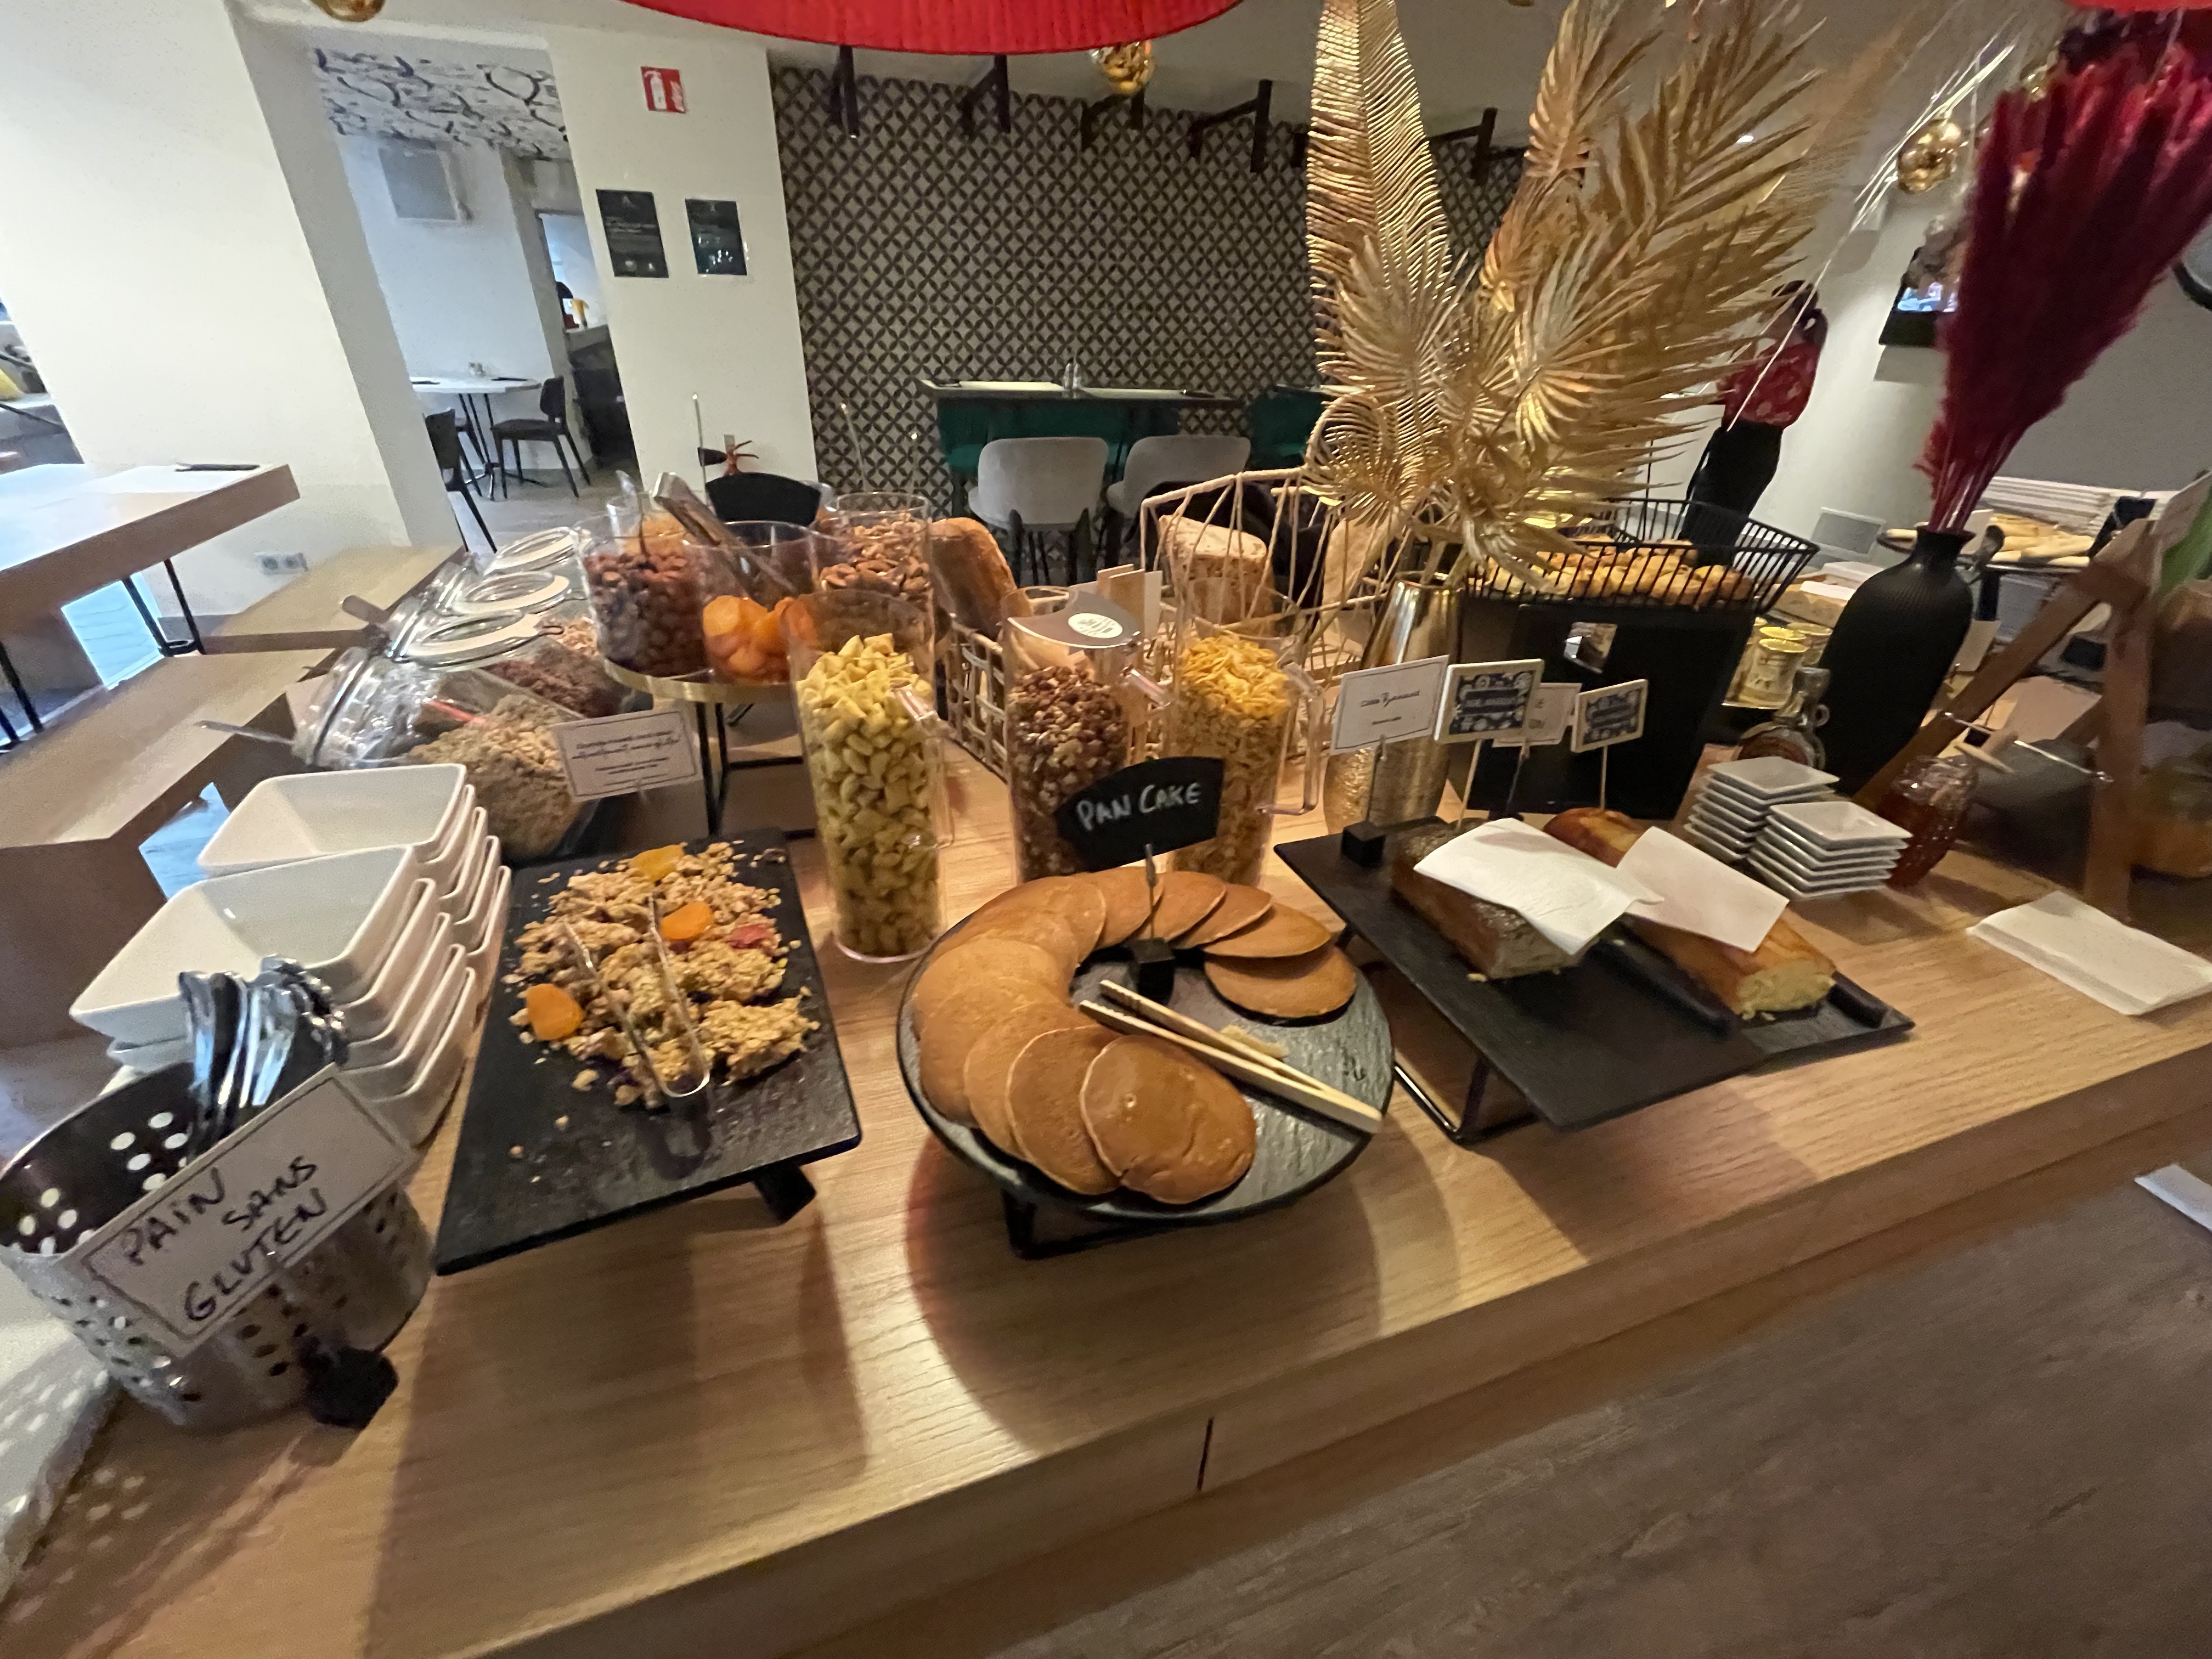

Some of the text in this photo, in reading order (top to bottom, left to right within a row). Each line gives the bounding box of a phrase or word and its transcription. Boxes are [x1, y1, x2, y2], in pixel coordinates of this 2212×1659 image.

[1076, 781, 1201, 831] PAN CAKE
[223, 1155, 318, 1231] SANS
[183, 1187, 328, 1322] GLUTEN
